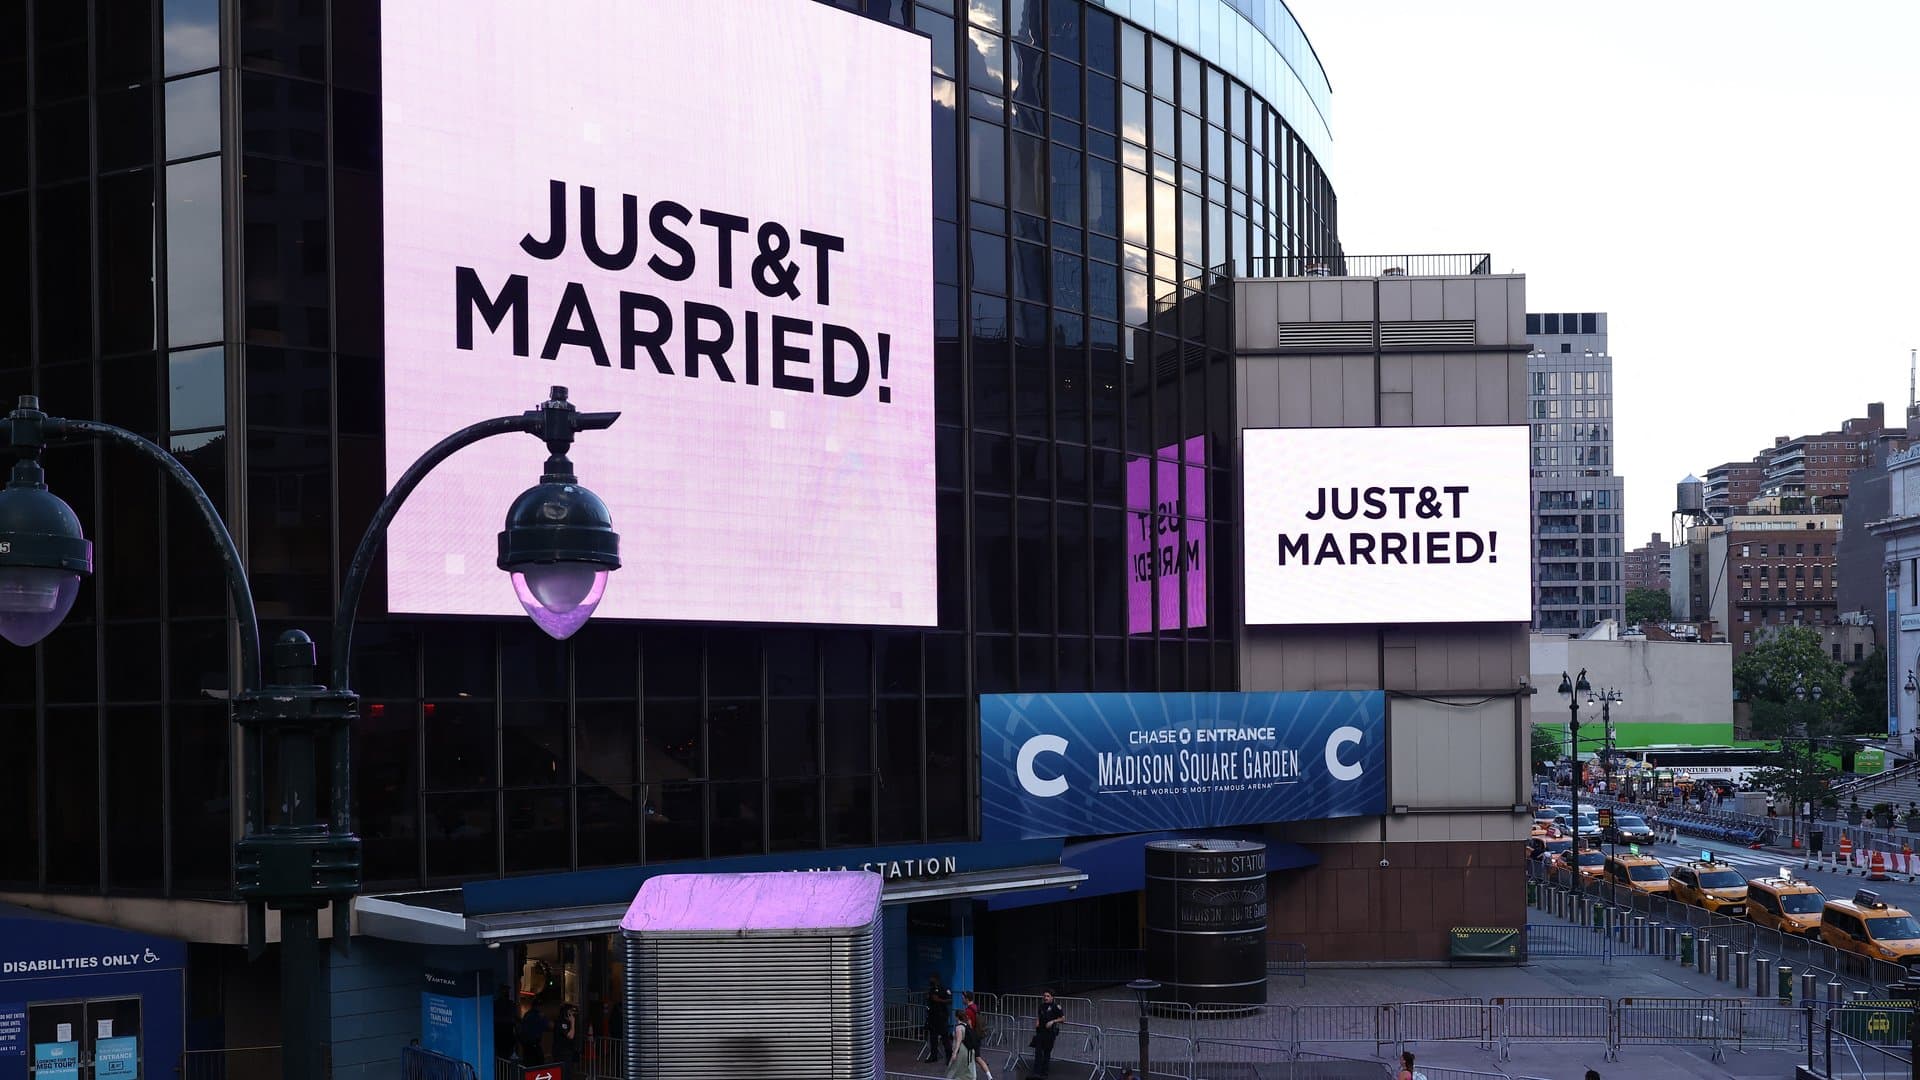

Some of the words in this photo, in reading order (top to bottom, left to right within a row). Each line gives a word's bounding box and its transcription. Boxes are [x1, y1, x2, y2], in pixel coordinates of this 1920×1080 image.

[519, 179, 844, 306] JUST&T
[455, 265, 892, 404] MARRIED!
[1305, 486, 1469, 520] JUST&T
[1278, 531, 1497, 566] MARRIED!
[1129, 729, 1177, 744] CHASE
[1196, 727, 1276, 742] ENTRANCE
[1098, 752, 1174, 786] MADISON
[1179, 749, 1238, 784] SQUARE
[1151, 787, 1187, 795] WORLD'S
[1215, 784, 1245, 792] FAMOUS
[3, 956, 98, 973] DISABILITIES
[102, 954, 139, 967] ONLY
[99, 1052, 132, 1061] ENTRANCE
